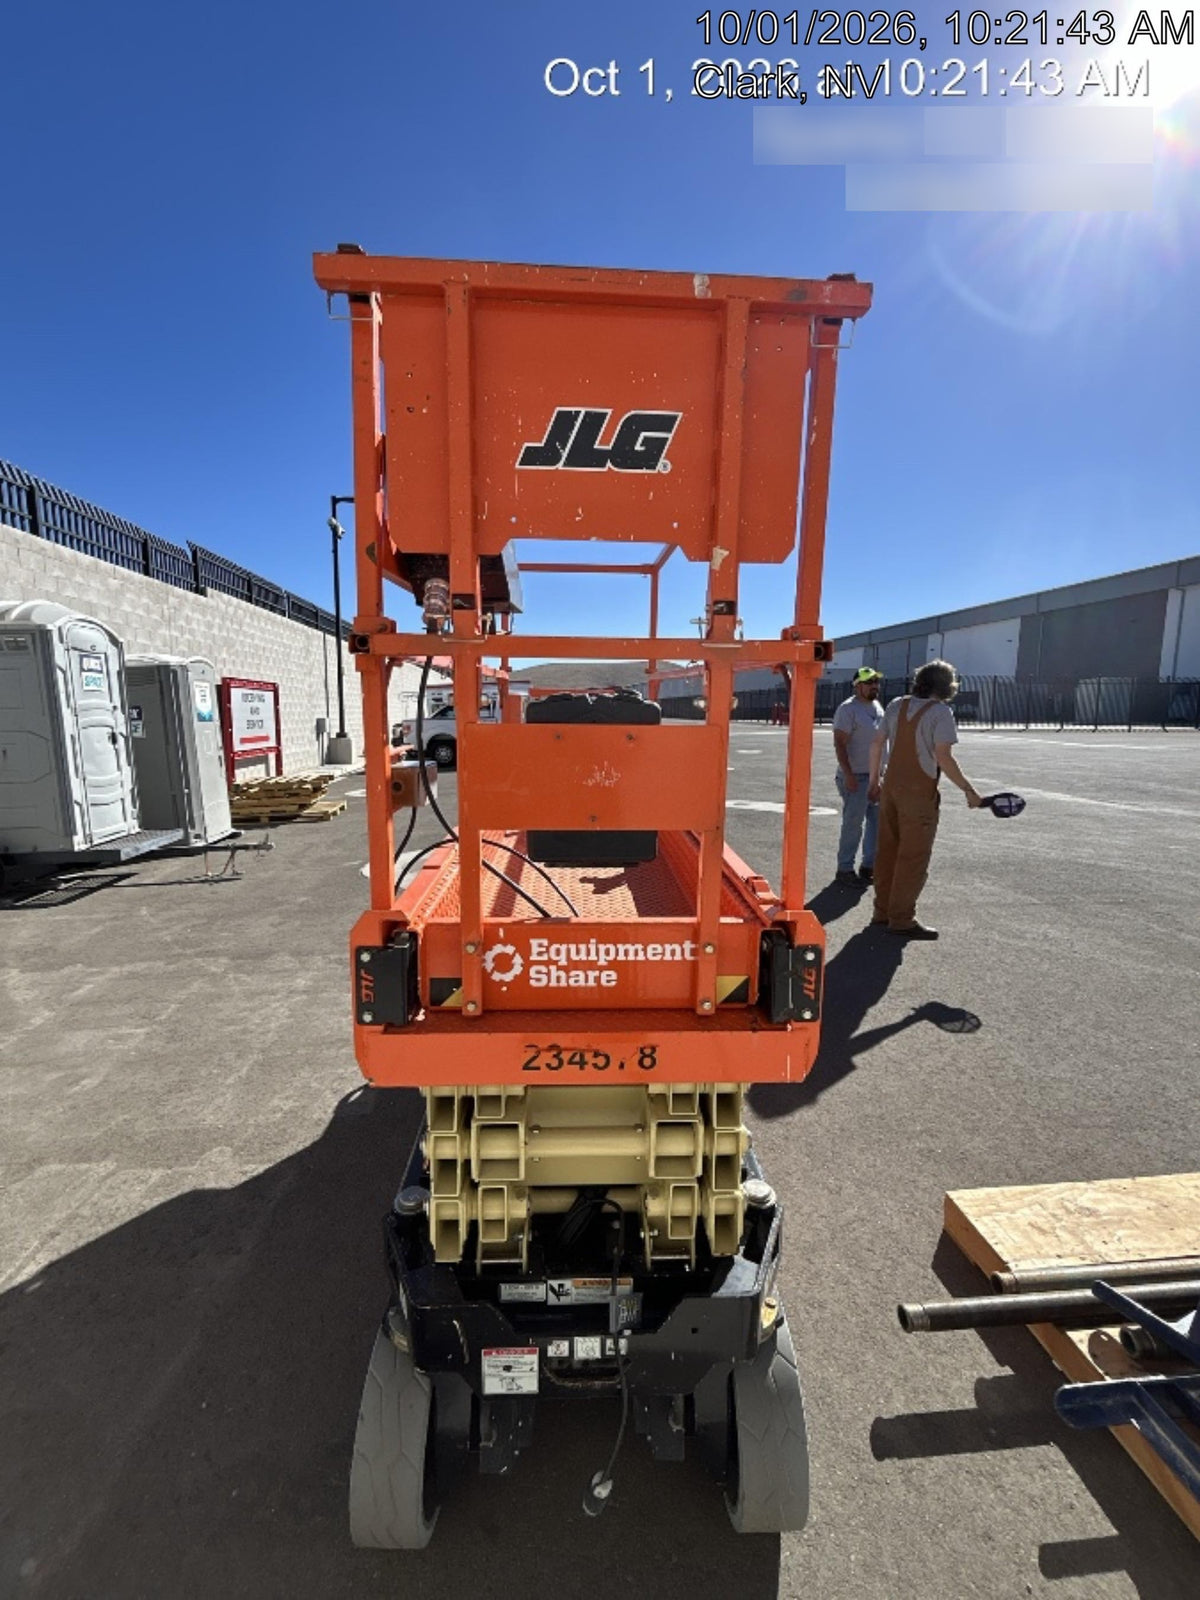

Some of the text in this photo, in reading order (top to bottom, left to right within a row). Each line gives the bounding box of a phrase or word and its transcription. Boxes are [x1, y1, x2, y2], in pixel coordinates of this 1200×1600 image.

[515, 406, 683, 473] JLG
[528, 938, 698, 966] Equipment
[361, 968, 375, 1004] JLG
[528, 964, 618, 988] Share
[521, 1044, 658, 1072] 23458
